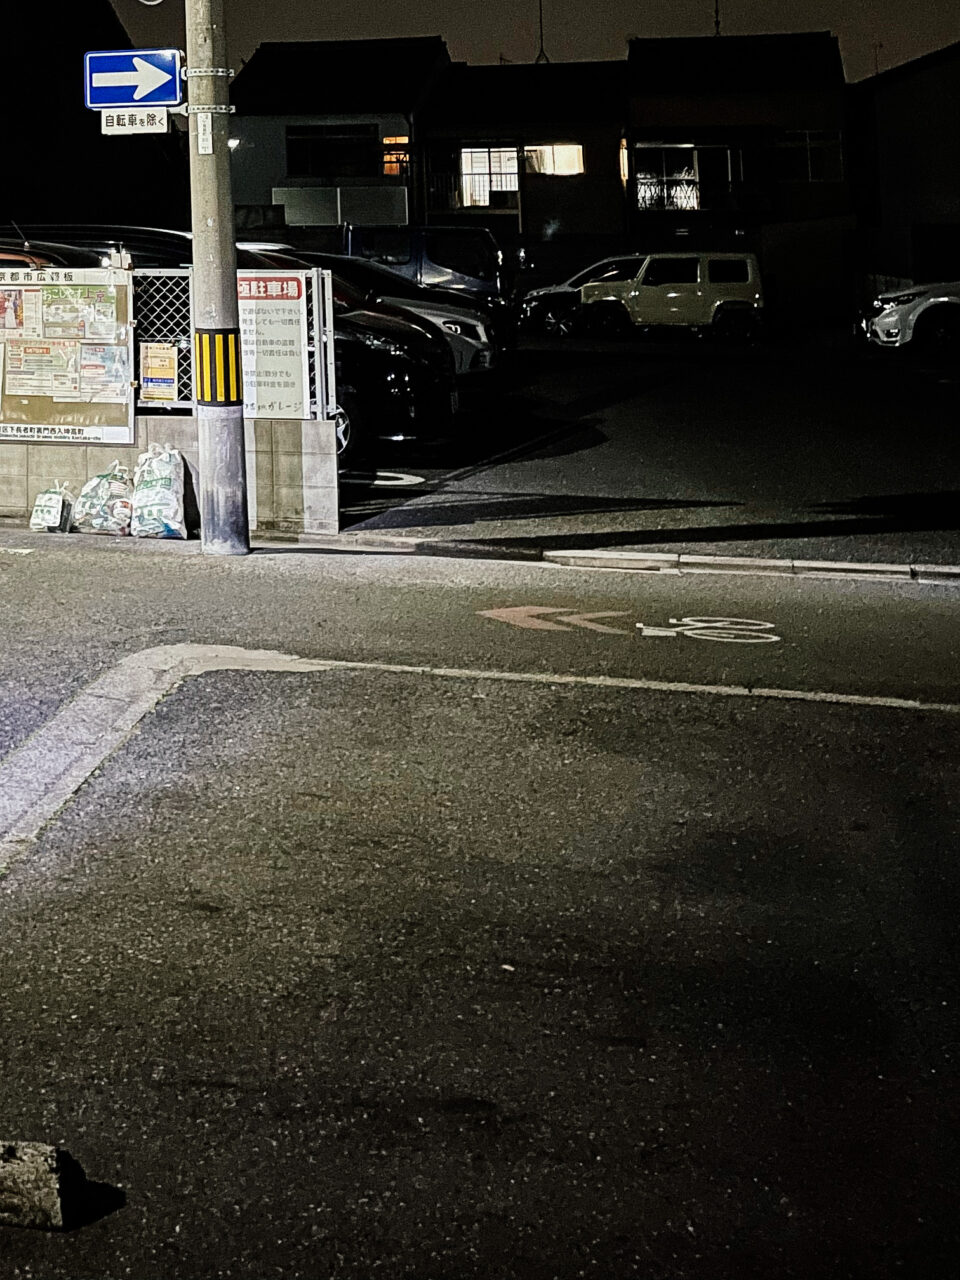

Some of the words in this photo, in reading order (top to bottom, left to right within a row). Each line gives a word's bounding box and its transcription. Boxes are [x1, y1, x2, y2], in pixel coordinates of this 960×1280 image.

[105, 113, 164, 127] 自転車を除く
